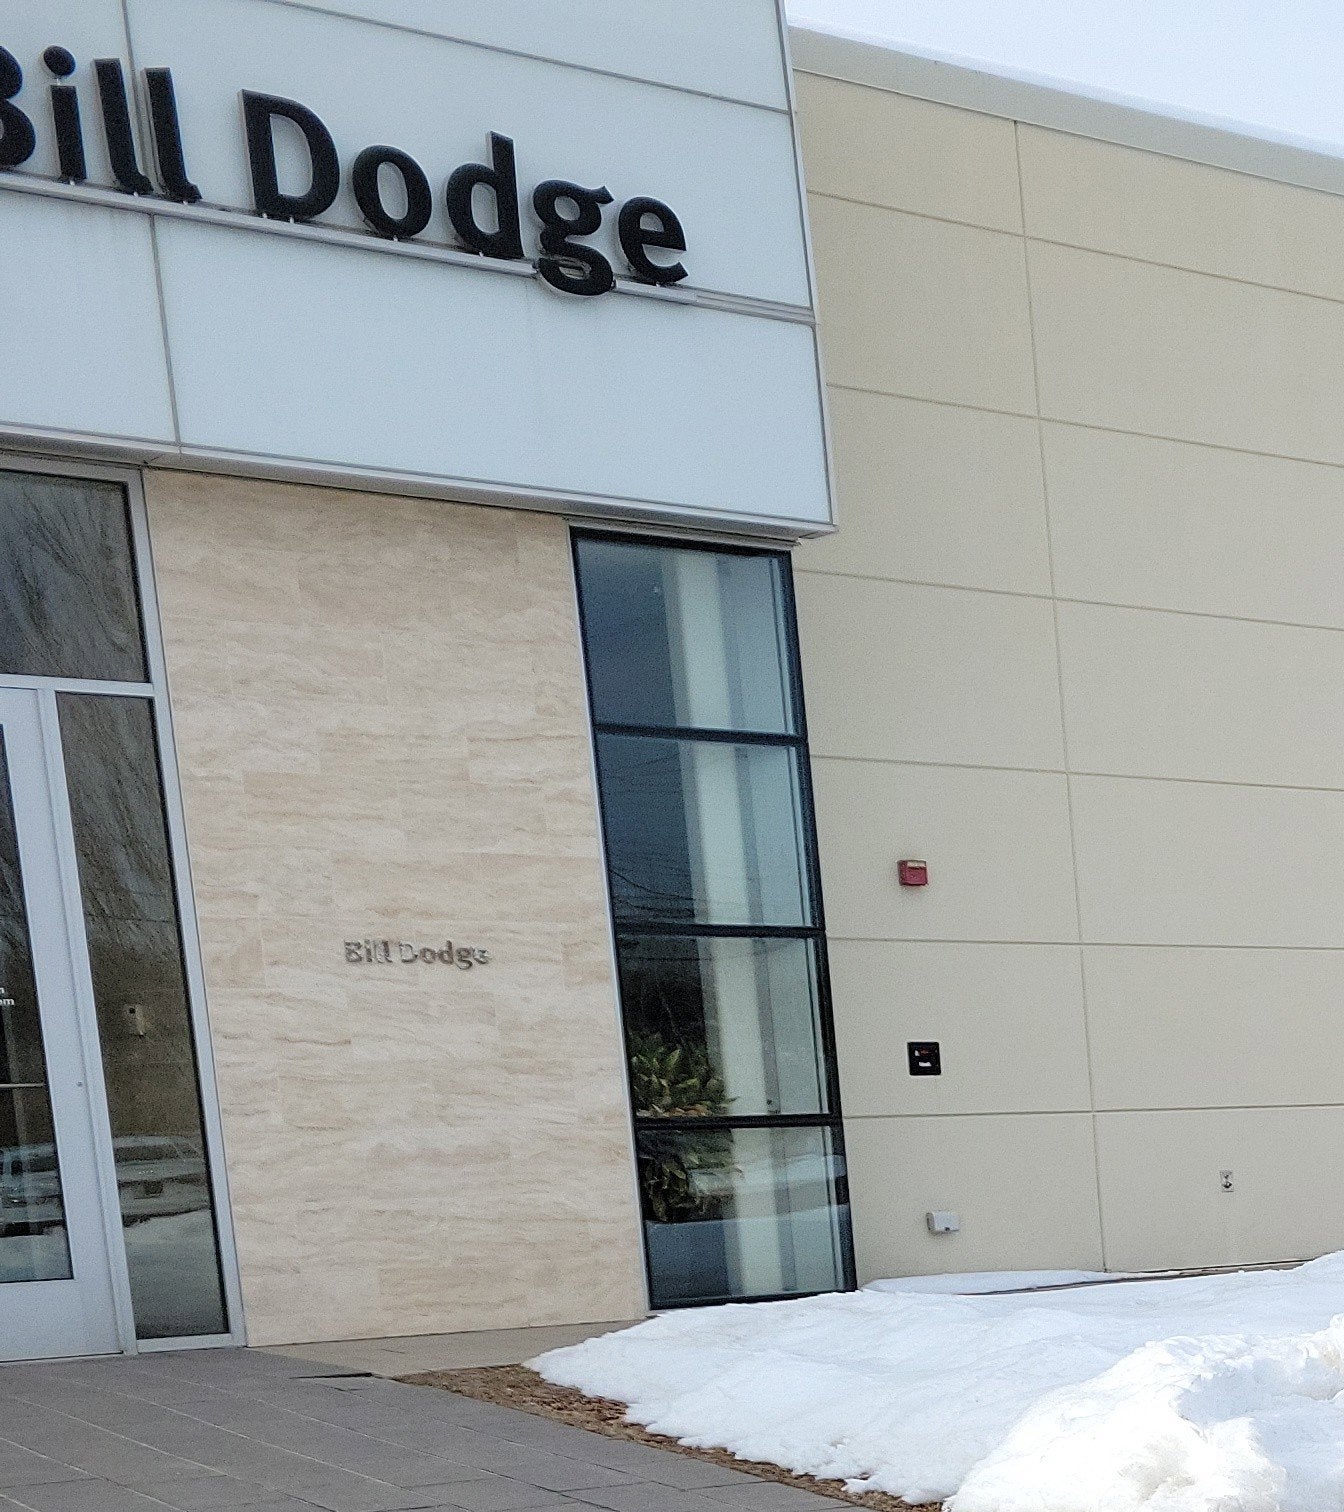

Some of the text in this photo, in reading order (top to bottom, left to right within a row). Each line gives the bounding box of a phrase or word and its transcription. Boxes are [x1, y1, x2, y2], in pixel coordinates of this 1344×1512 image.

[241, 88, 688, 296] Dodge
[343, 939, 491, 971] Bill Dodge
